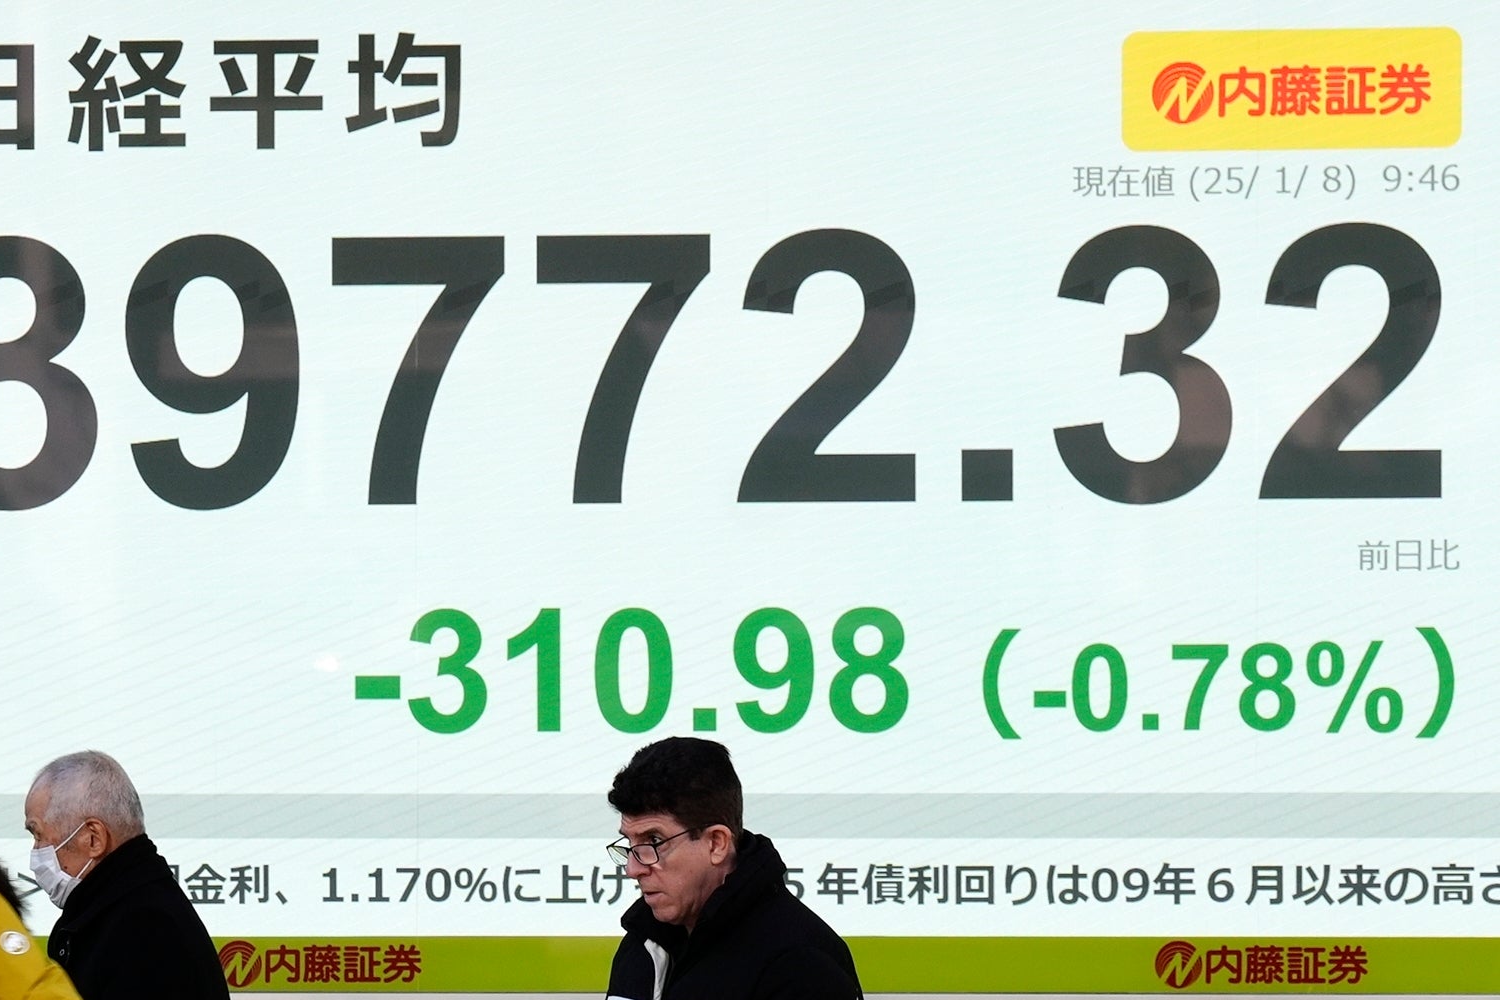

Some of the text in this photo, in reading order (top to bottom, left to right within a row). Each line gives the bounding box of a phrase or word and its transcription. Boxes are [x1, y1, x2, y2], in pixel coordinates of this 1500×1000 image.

[1217, 63, 1432, 118] 内藤証券
[1072, 166, 1176, 198] 現在値
[1381, 163, 1461, 194] 9:46
[1357, 540, 1461, 573] 前日比
[354, 605, 909, 735] -310.98
[981, 625, 1456, 739] (-0.78%)
[264, 943, 422, 985] 内藤証券
[1205, 943, 1369, 986] 内藤証券
